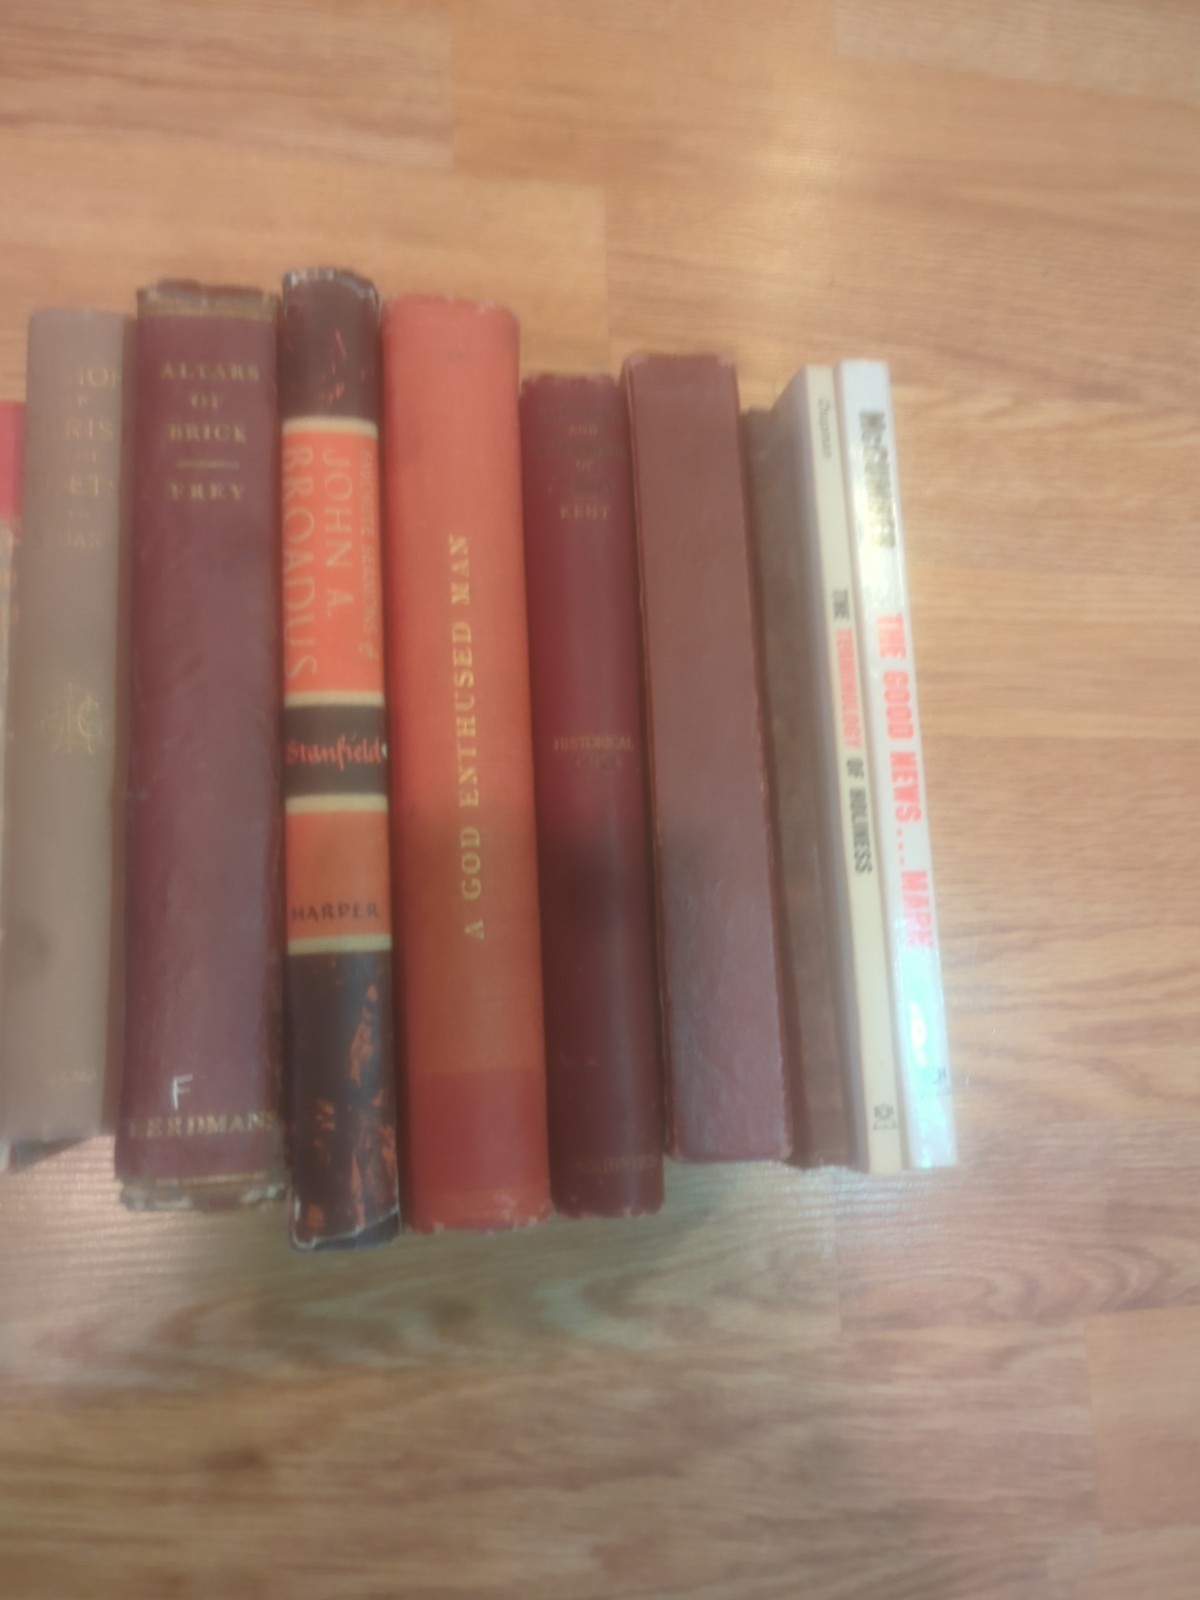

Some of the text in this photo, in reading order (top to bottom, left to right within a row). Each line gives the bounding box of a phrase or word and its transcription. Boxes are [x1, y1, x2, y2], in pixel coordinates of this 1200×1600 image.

[161, 362, 260, 382] ALTARS
[191, 393, 221, 410] OF
[168, 424, 246, 444] BRICK
[322, 450, 353, 568] JOHN
[282, 446, 318, 679] BROADUS
[877, 613, 907, 658] THE
[882, 669, 914, 739] GOOD
[448, 534, 485, 941] A GOD ENTHUSED MAN
[846, 757, 864, 779] OF
[849, 787, 872, 874] HOLINESS
[291, 902, 379, 922] HARPER
[171, 1074, 193, 1111] F
